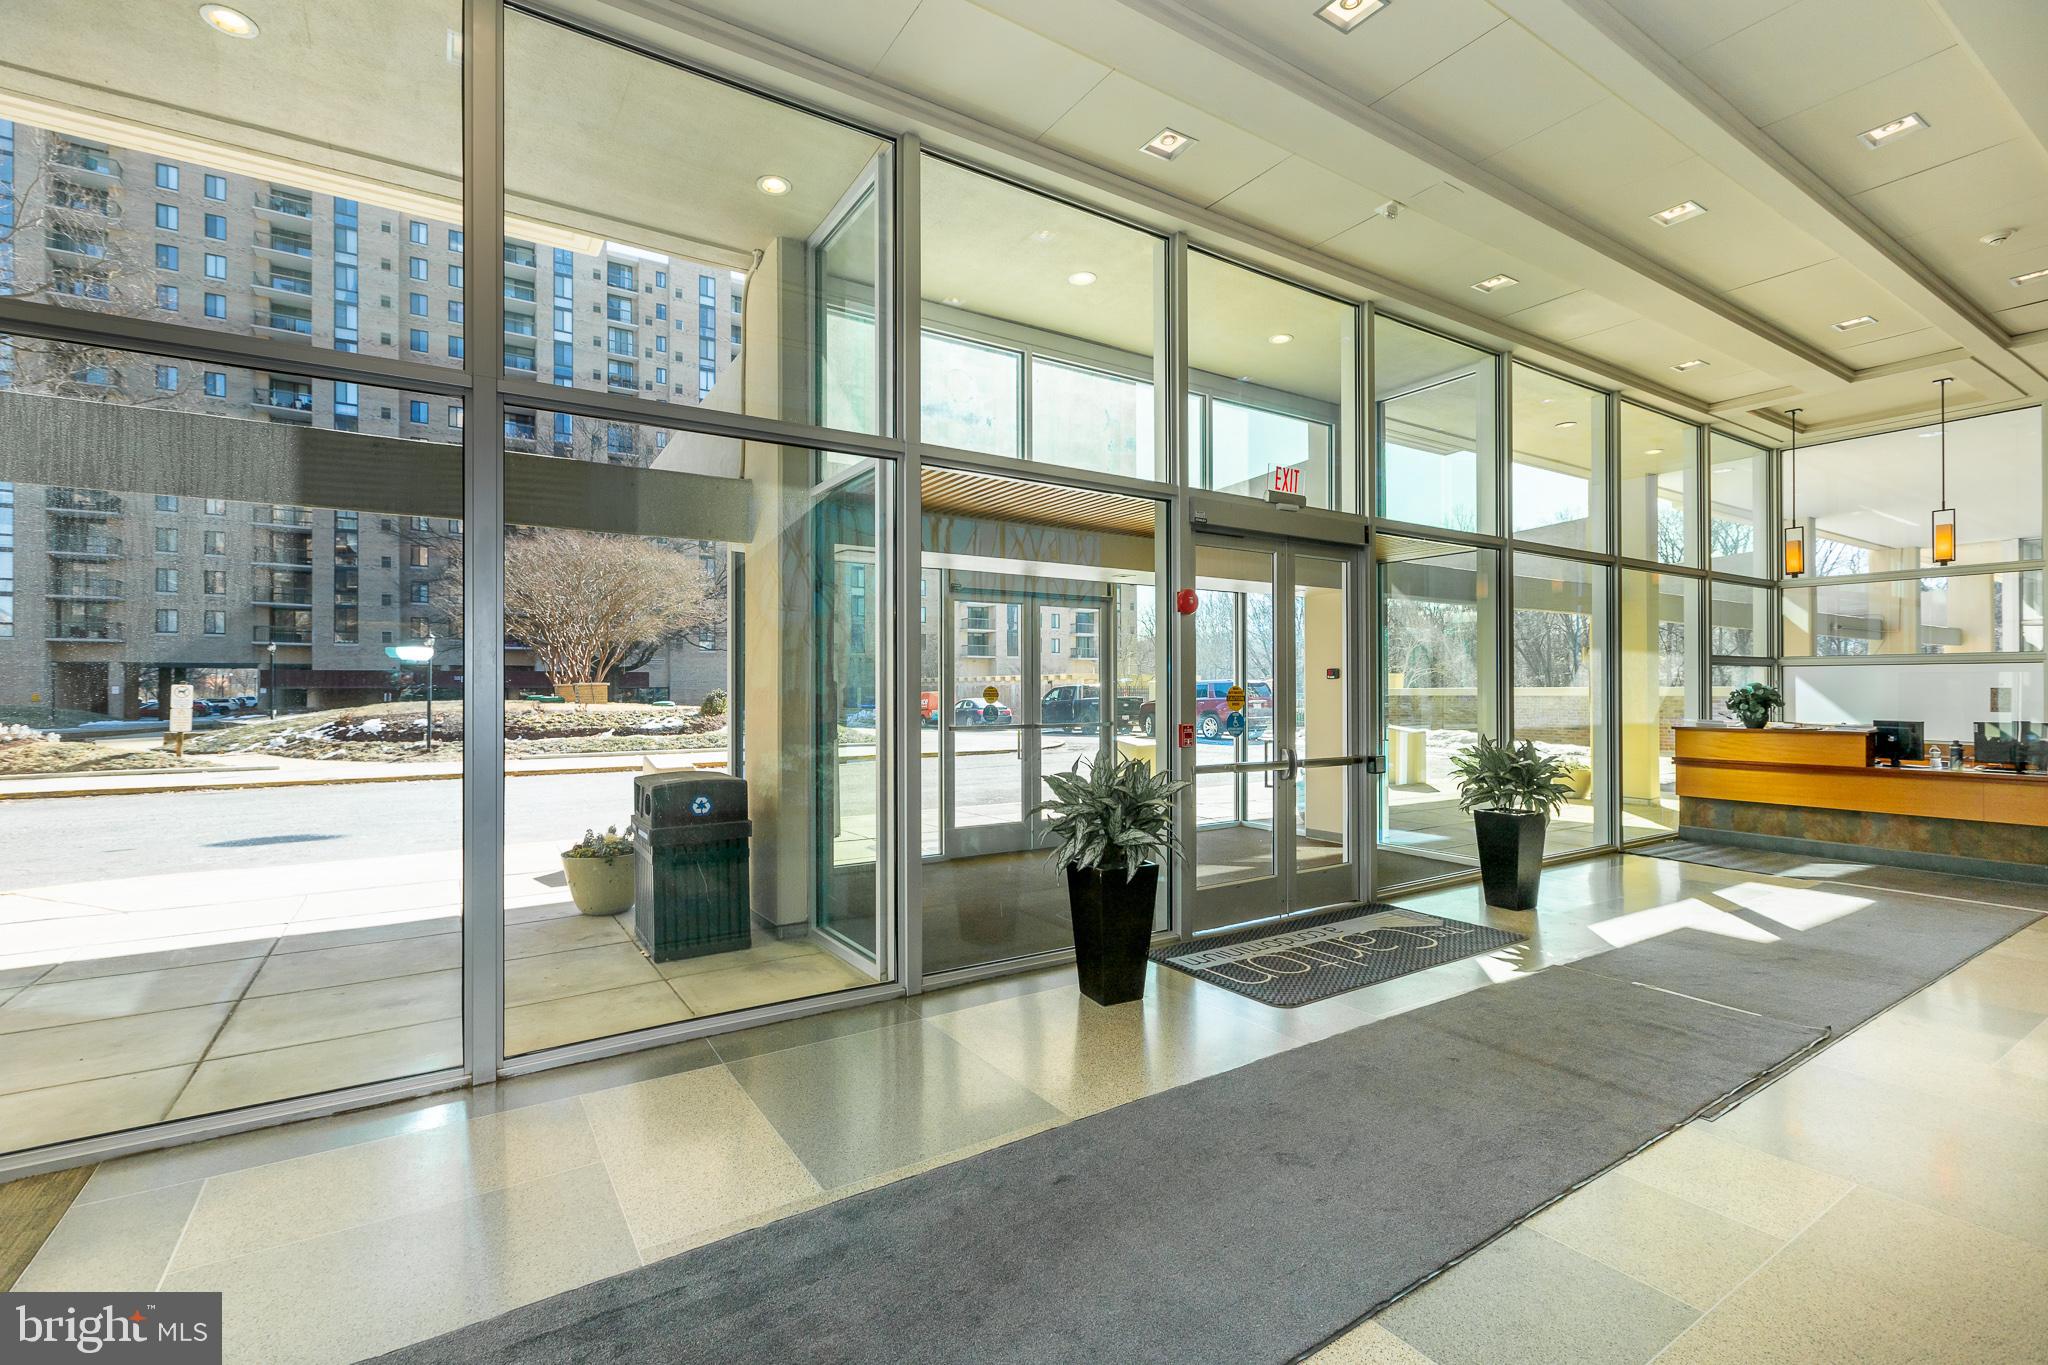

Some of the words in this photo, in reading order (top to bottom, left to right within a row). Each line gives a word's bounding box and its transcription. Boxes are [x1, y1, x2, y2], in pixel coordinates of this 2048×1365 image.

[1275, 466, 1300, 493] EXIT
[1326, 926, 1343, 934] a
[1422, 925, 1475, 938] The
[1179, 930, 1327, 966] condominium
[1203, 928, 1438, 985] Carlton
